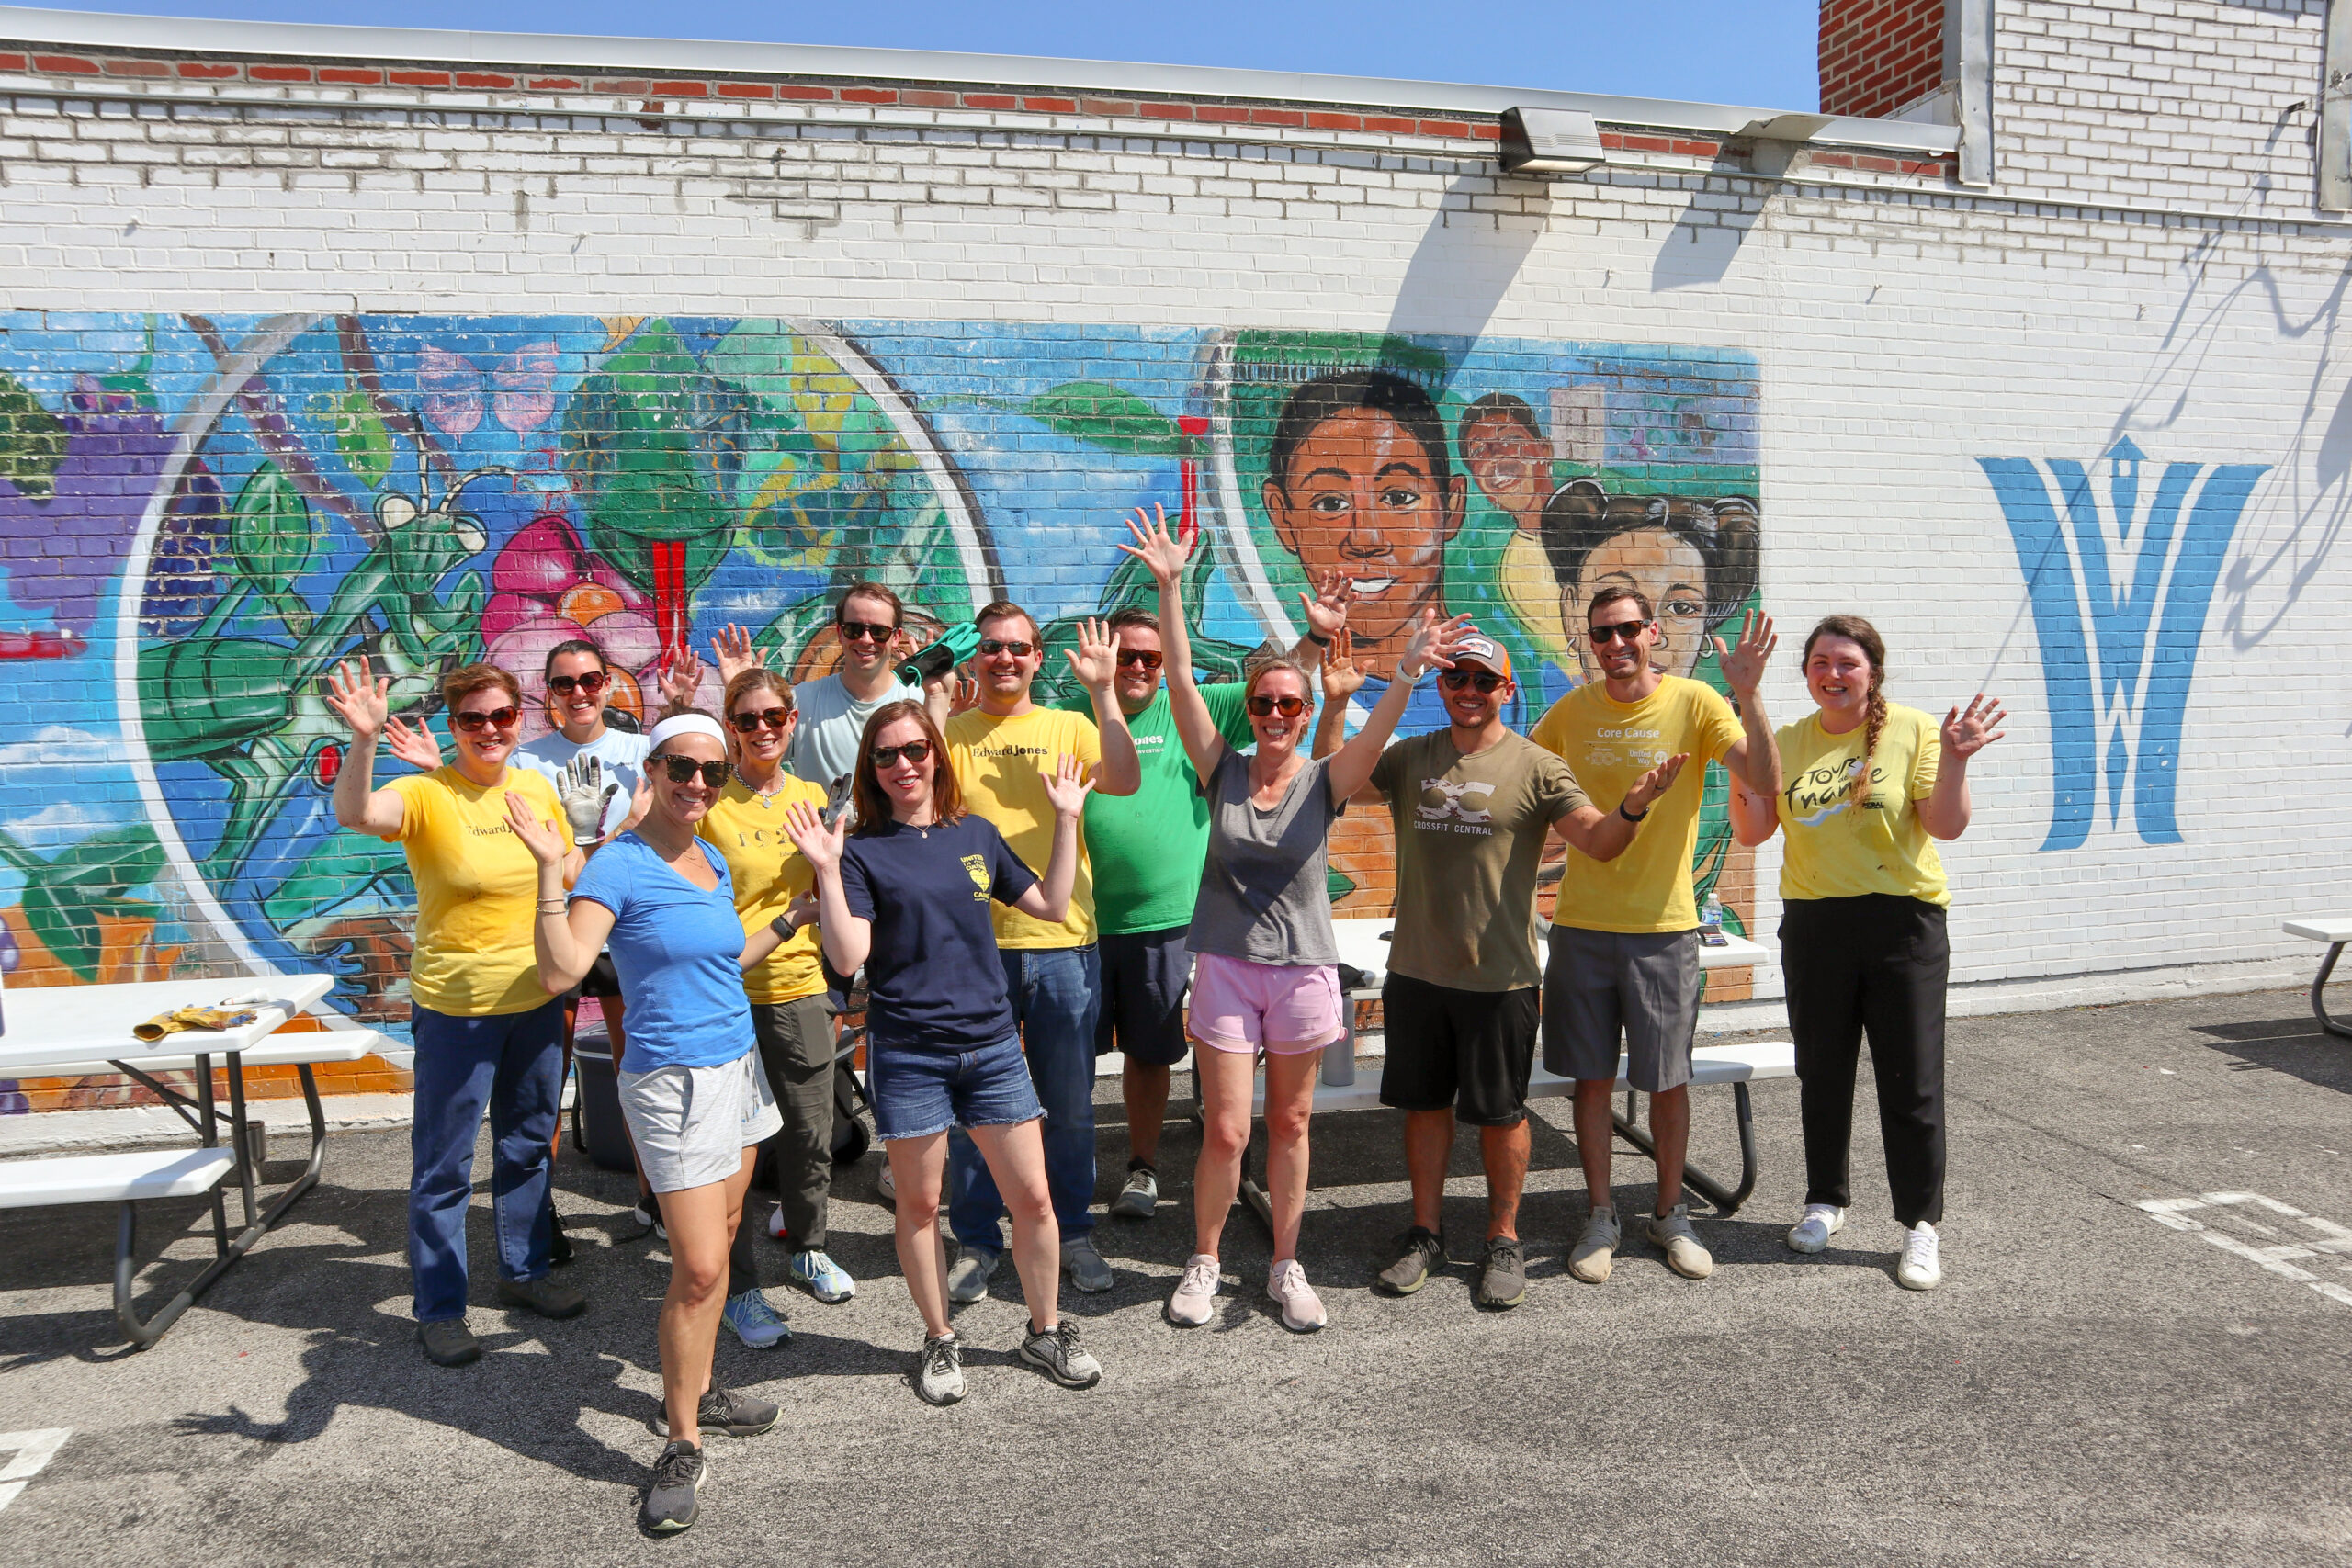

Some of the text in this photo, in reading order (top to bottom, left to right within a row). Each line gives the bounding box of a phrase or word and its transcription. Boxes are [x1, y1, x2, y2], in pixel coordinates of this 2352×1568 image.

[1597, 727, 1660, 739] Core Cause
[1134, 735, 1164, 745] ones
[1629, 750, 1652, 758] United
[1637, 757, 1650, 766] Way
[1785, 767, 1891, 816] frane
[1414, 820, 1493, 836] CROSSFIT CENTRAL
[738, 828, 791, 847] 192
